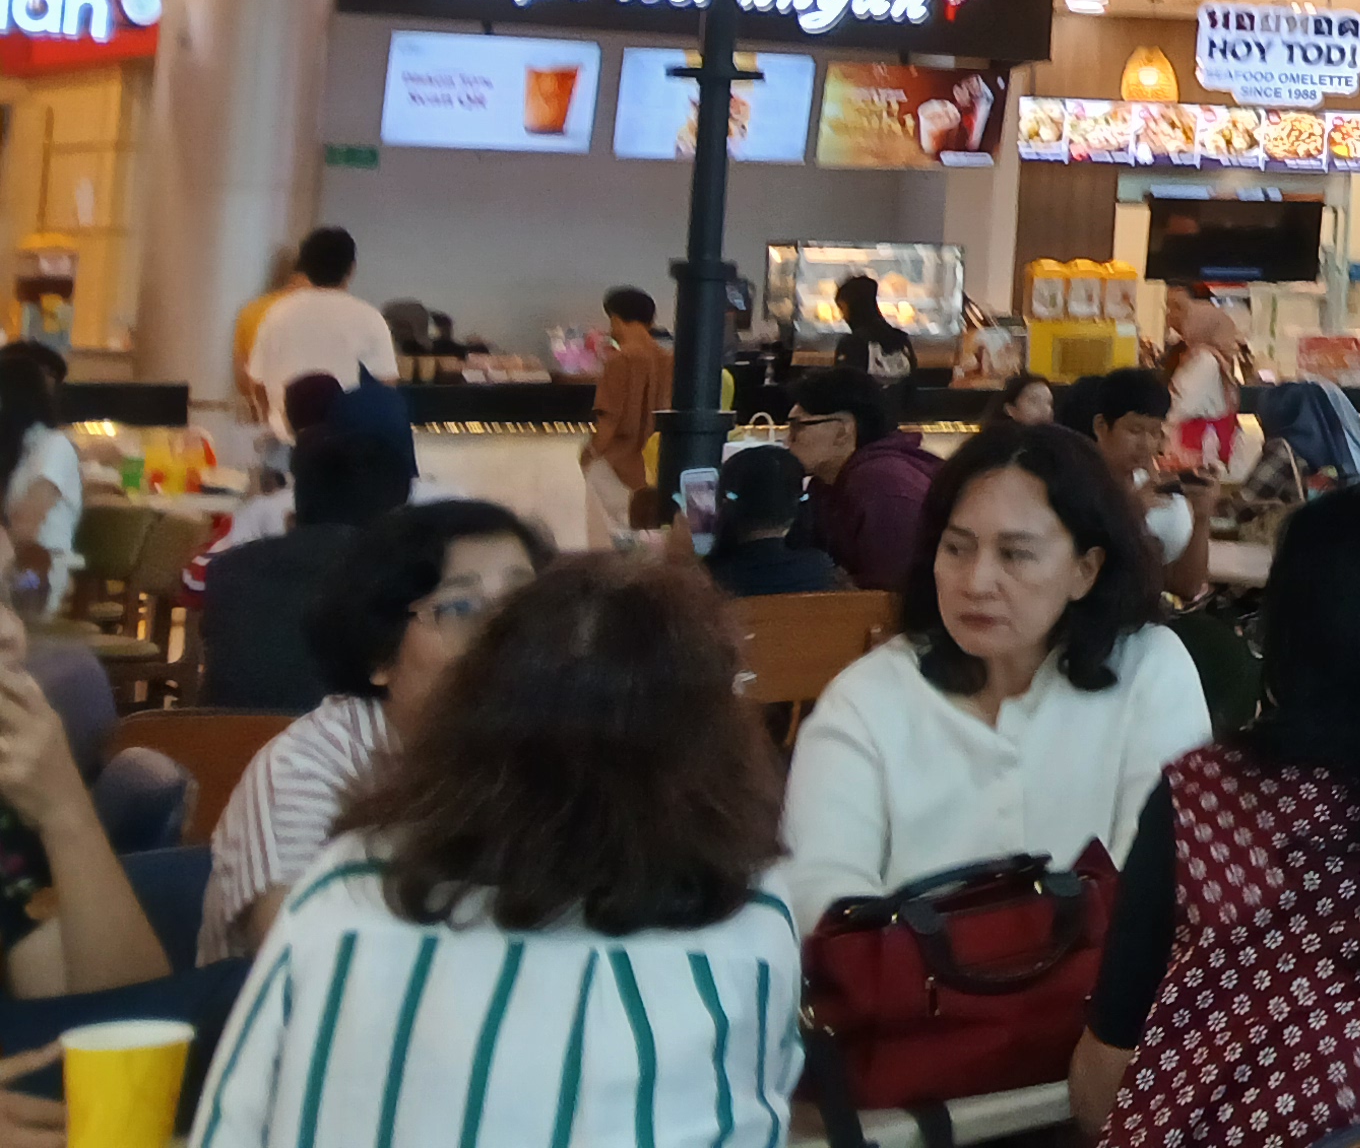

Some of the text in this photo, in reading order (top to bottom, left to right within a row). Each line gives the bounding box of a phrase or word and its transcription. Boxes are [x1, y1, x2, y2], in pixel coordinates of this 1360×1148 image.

[1208, 36, 1271, 63] HOY
[1278, 73, 1353, 87] OMELETTE
[1241, 87, 1317, 100] SINCE 1988
